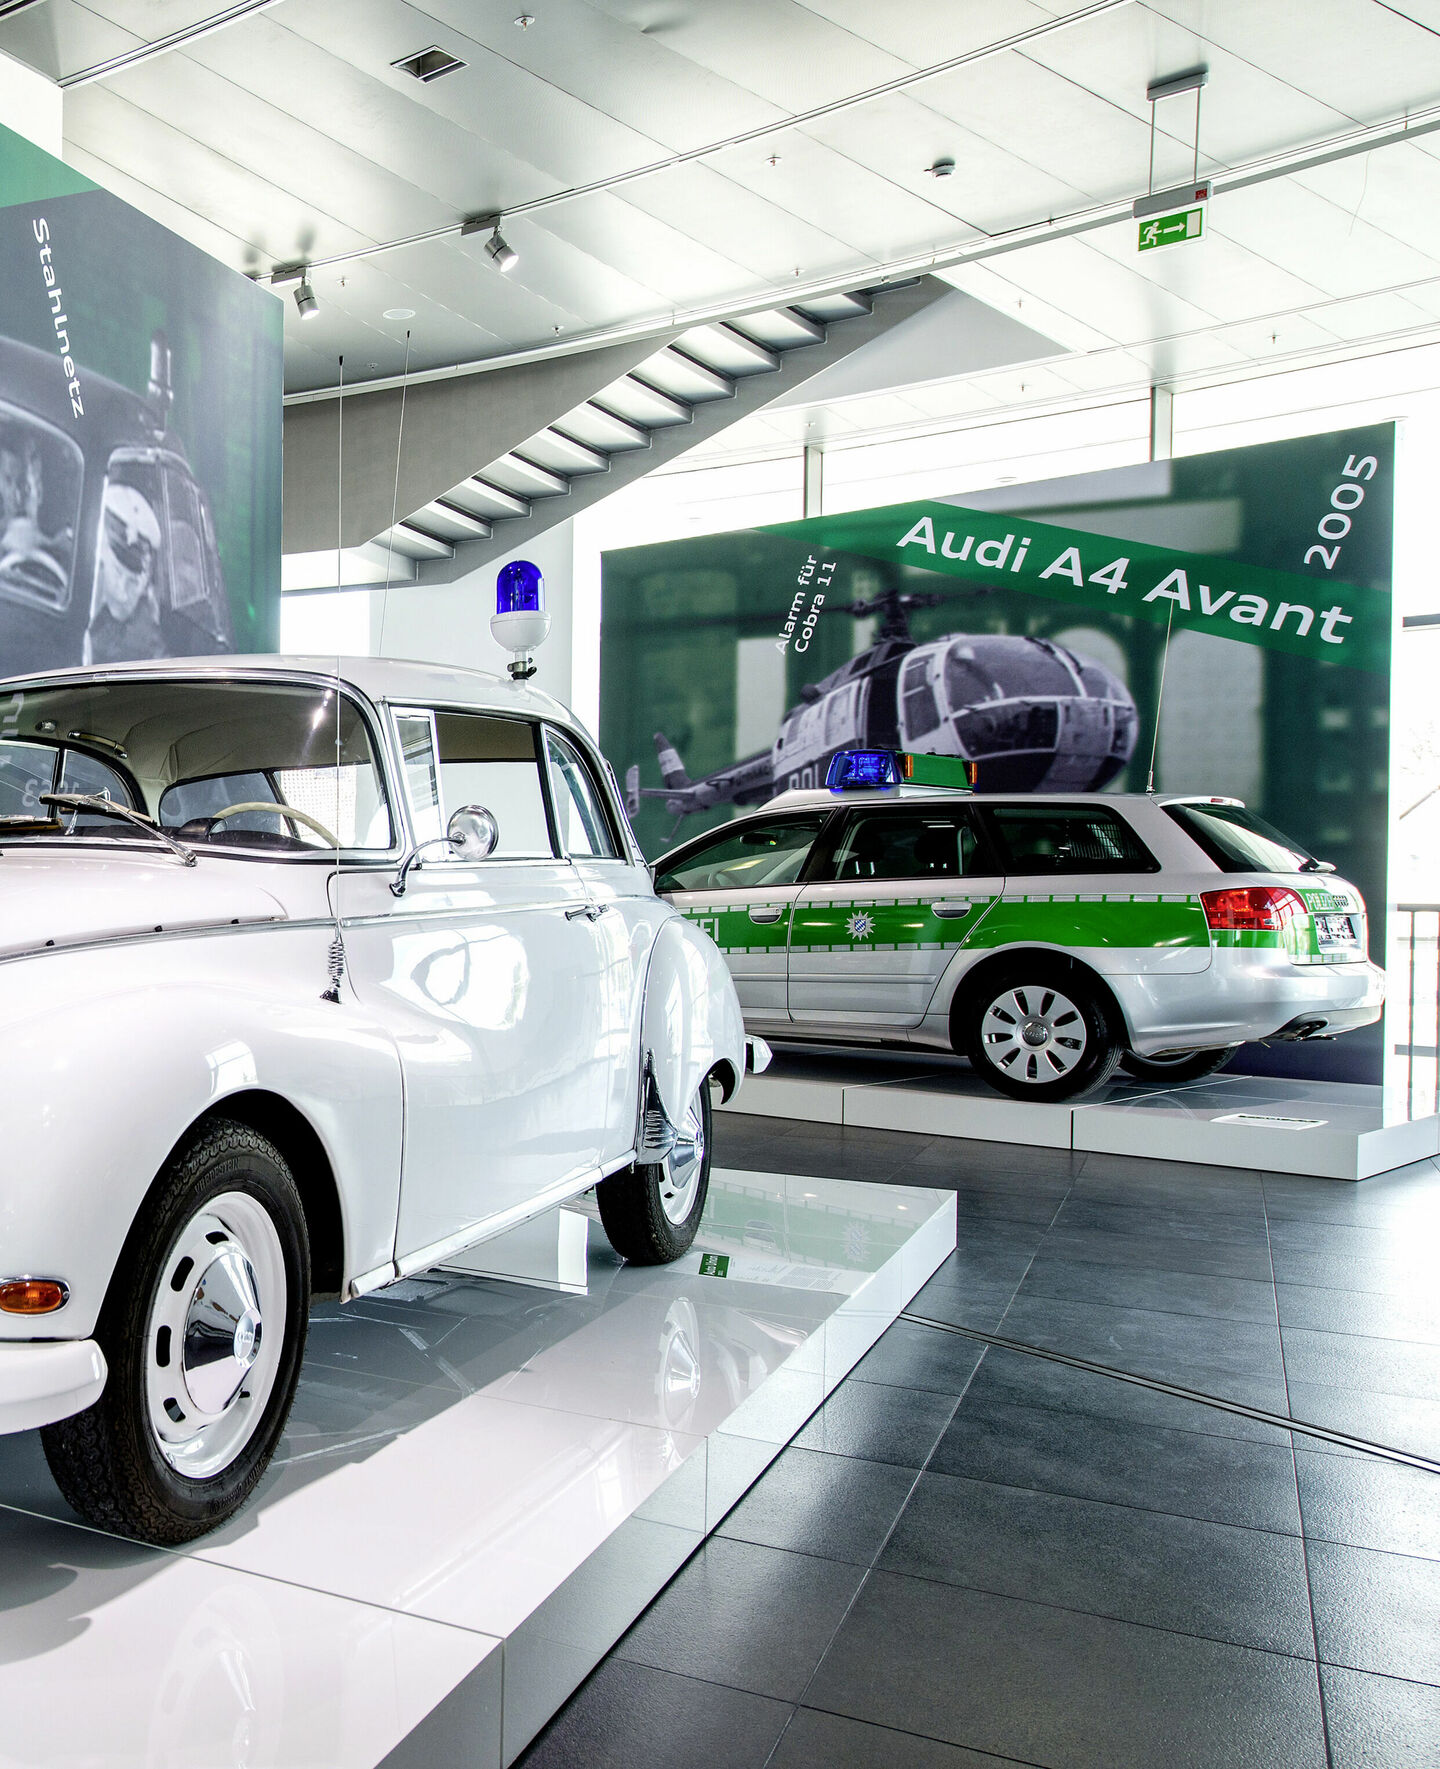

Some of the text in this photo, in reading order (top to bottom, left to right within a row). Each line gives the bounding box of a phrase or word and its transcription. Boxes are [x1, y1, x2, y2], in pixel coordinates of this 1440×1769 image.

[32, 217, 85, 419] Stahlnetz
[1303, 455, 1378, 570] 2005
[775, 554, 817, 655] Alarm für
[795, 562, 837, 653] Cobra 11
[896, 517, 1353, 644] Audi A4 Avant
